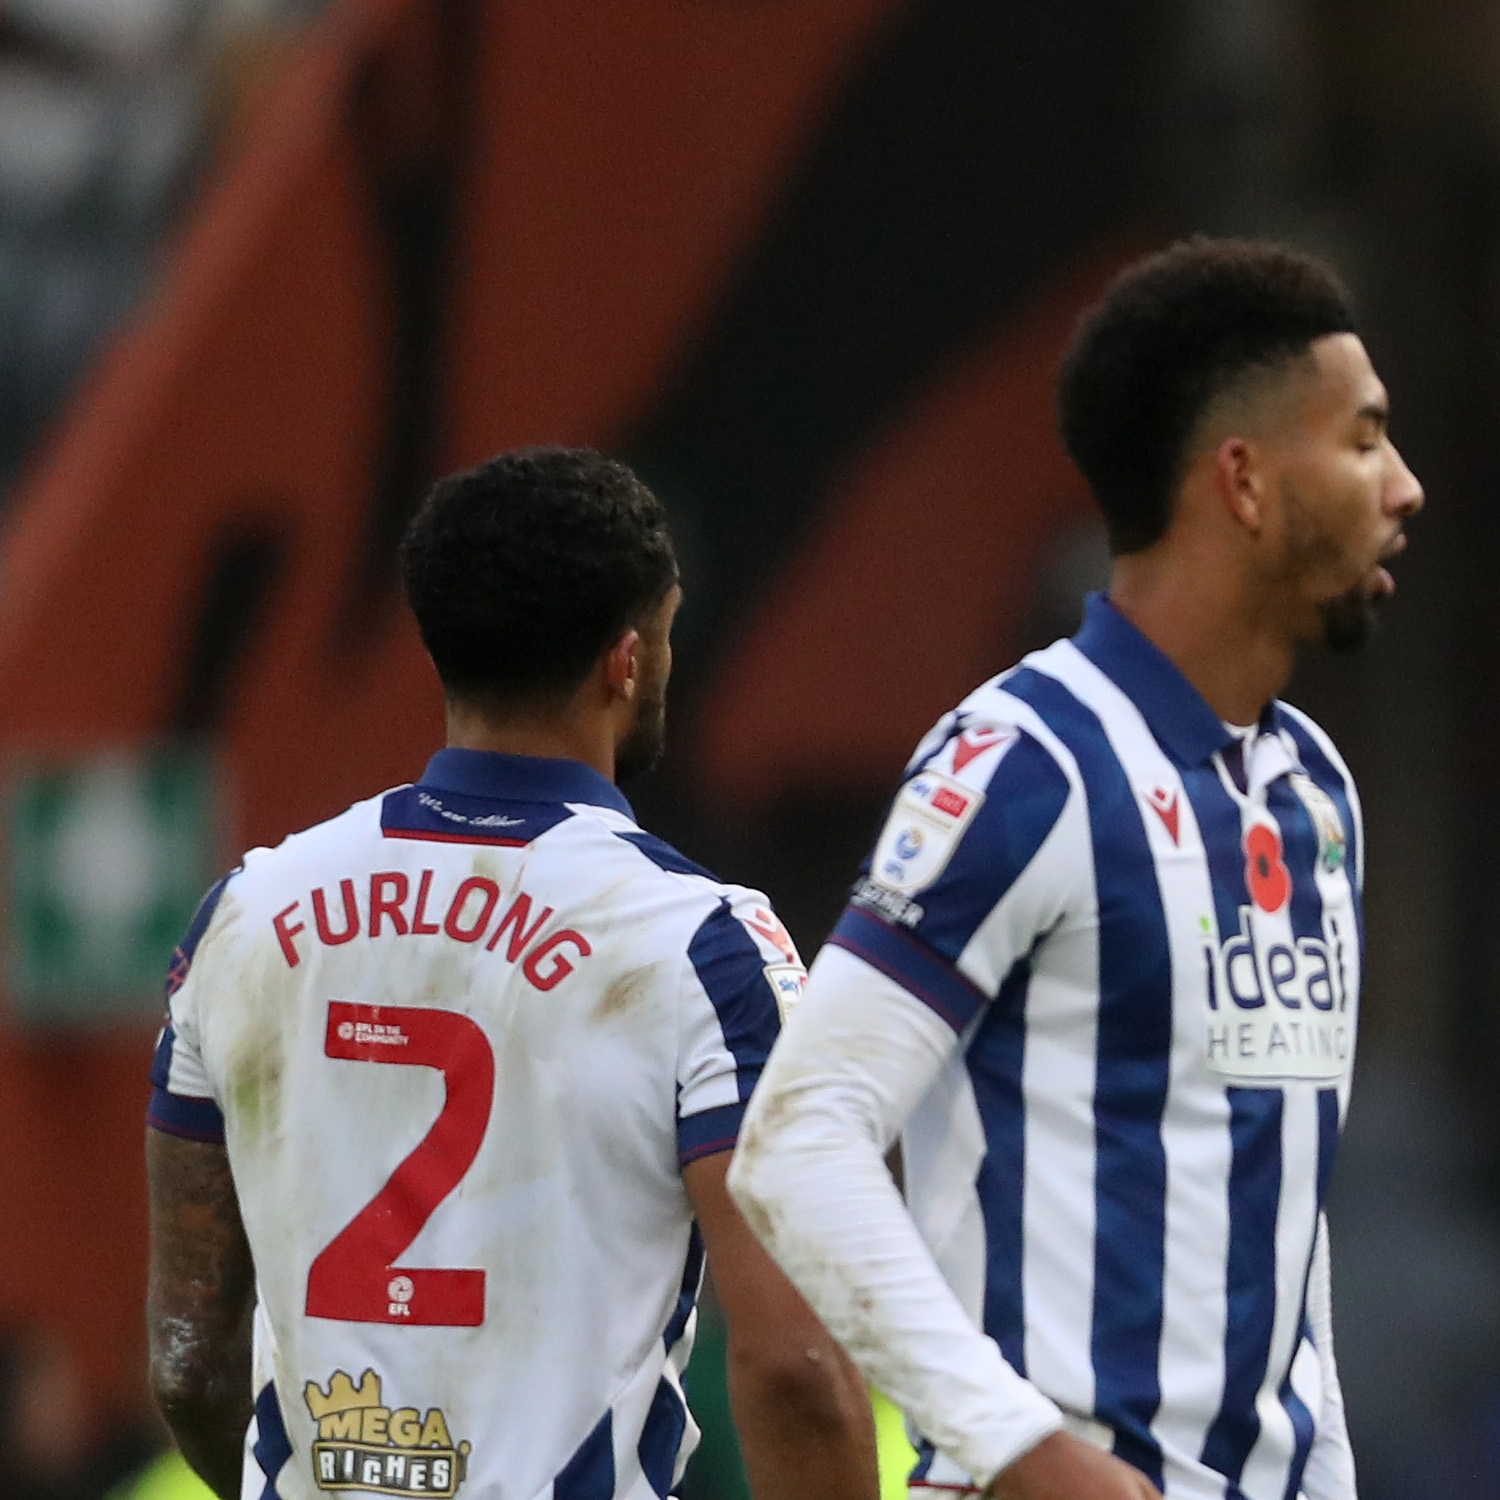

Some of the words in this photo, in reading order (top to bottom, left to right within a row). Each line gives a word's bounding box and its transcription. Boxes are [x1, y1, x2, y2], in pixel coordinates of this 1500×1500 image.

[272, 868, 592, 992] FURLONG
[1199, 907, 1346, 1012] ideal
[304, 1000, 496, 1328] 2
[388, 1302, 411, 1317] EFL
[317, 1406, 454, 1449] MEGA
[319, 1449, 450, 1491] RICHES
